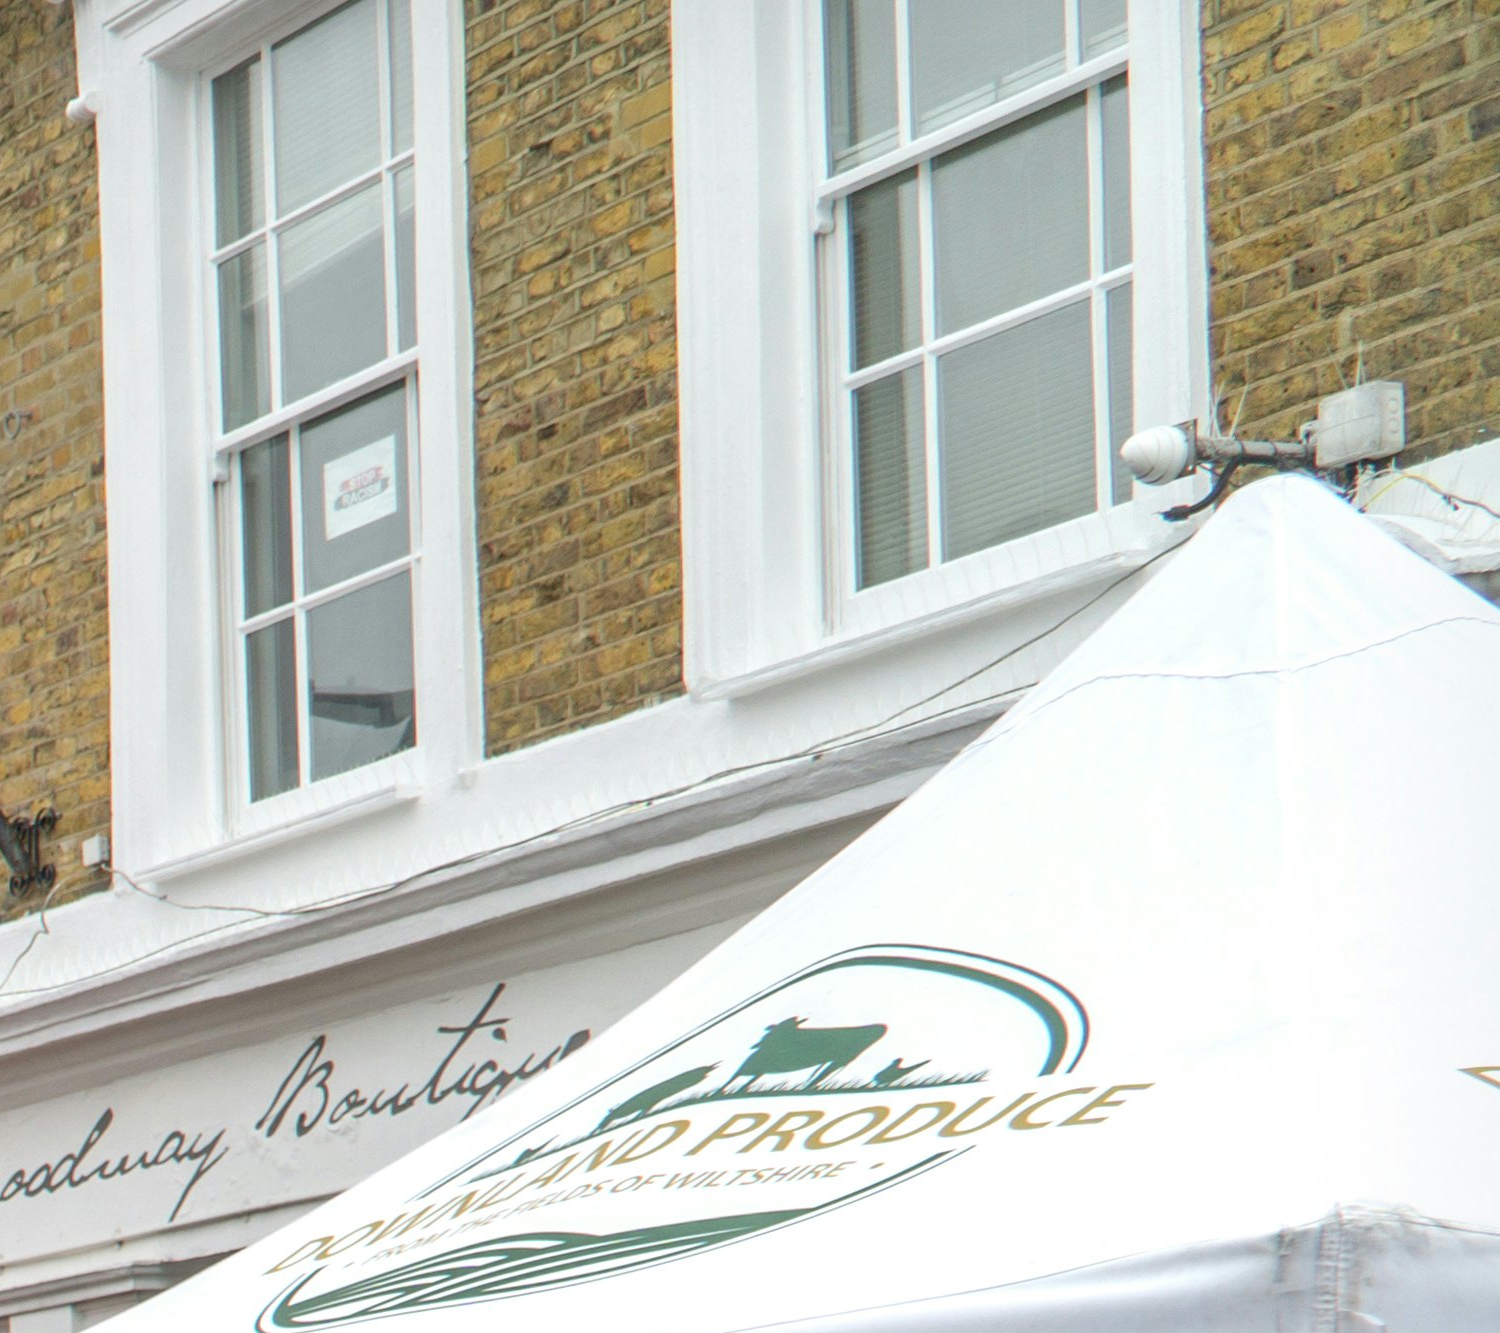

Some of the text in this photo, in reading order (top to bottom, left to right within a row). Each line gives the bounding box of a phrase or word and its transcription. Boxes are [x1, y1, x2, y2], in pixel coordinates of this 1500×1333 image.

[261, 1083, 1156, 1276] DOWNLAND PRODUCE
[500, 1181, 609, 1220] FIELDS
[609, 1174, 665, 1193] OF
[662, 1160, 858, 1189] WILTSHIRE
